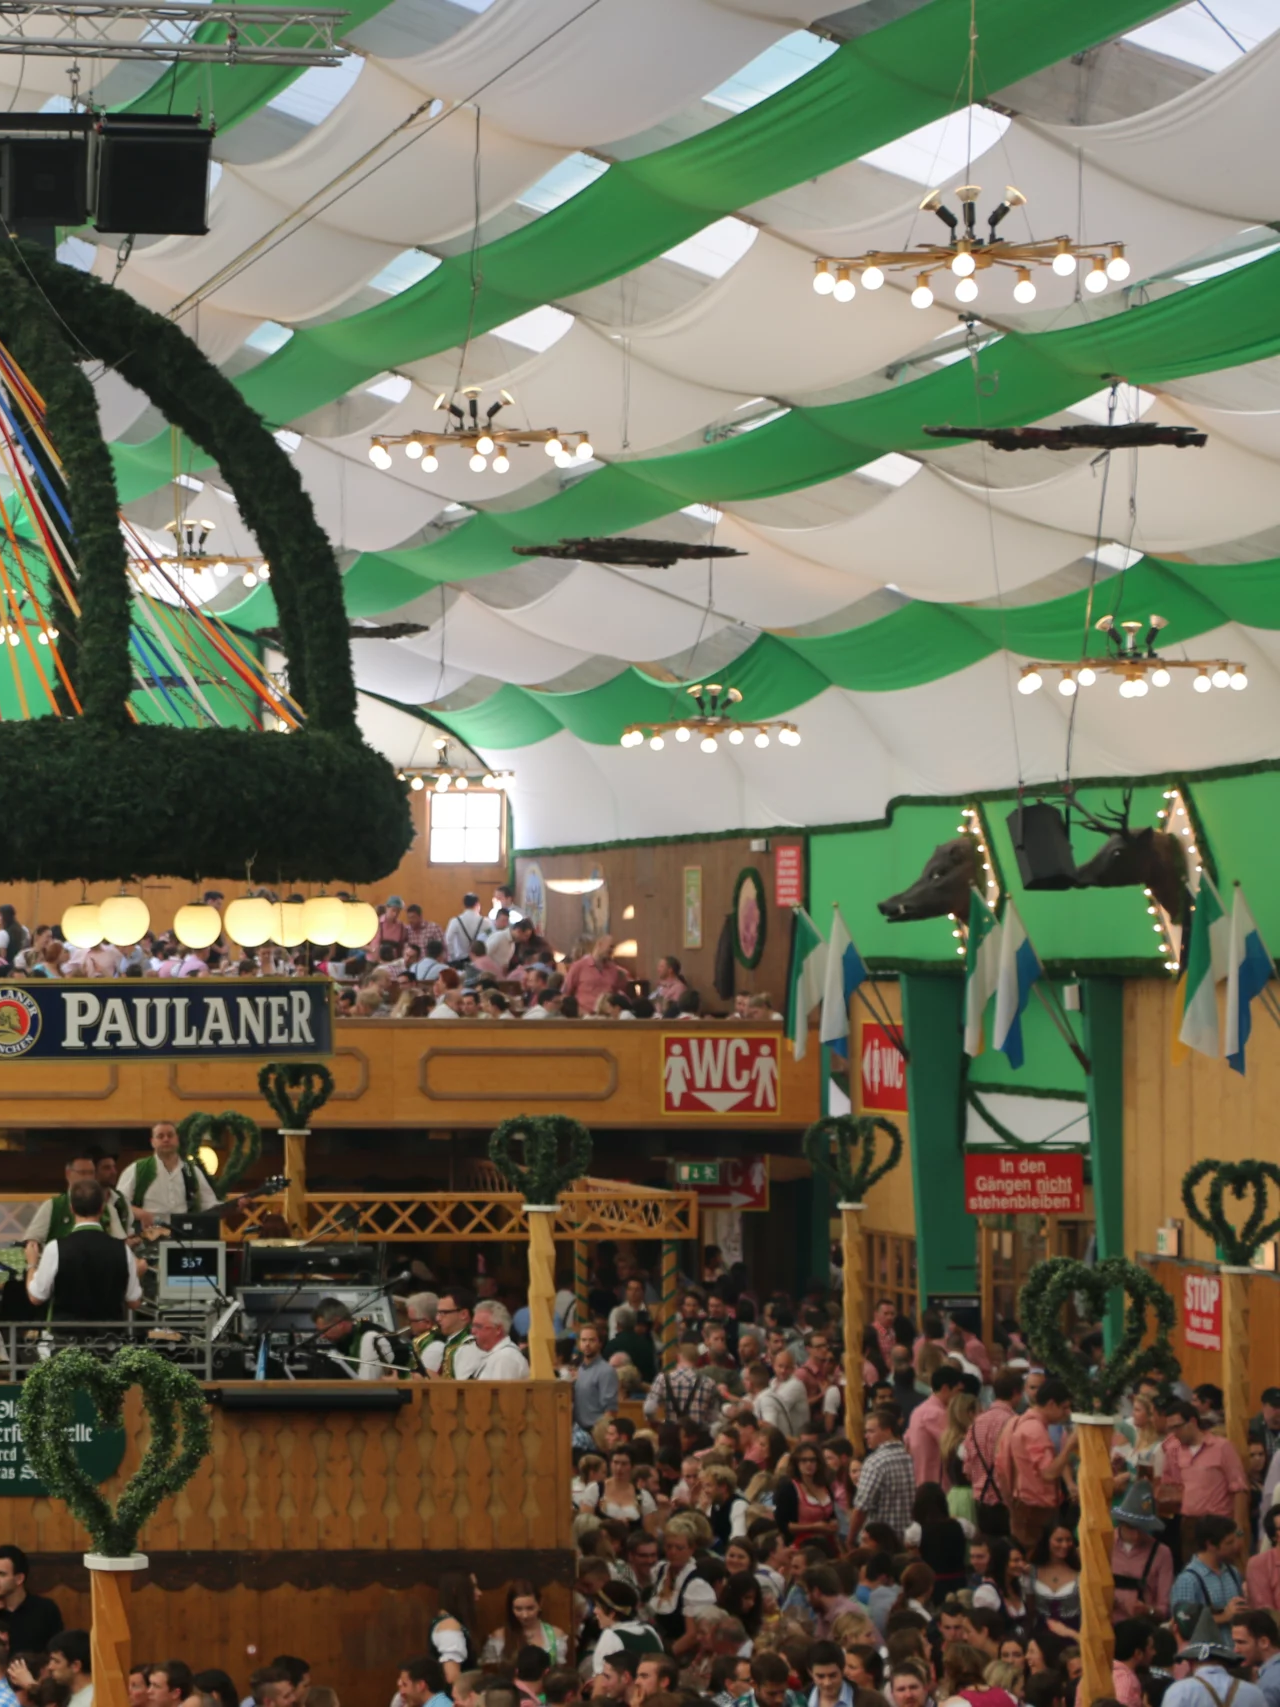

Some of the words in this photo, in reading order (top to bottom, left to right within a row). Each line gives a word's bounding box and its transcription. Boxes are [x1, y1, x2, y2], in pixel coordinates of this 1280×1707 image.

[61, 990, 316, 1049] PAULANER
[689, 1038, 751, 1090] WC
[882, 1047, 904, 1089] WC
[1000, 1158, 1014, 1173] In
[1018, 1158, 1046, 1173] den
[969, 1195, 1070, 1209] stehenbleiben
[975, 1176, 1031, 1195] Gängen
[1036, 1176, 1072, 1193] nicht
[1186, 1275, 1219, 1313] STOP
